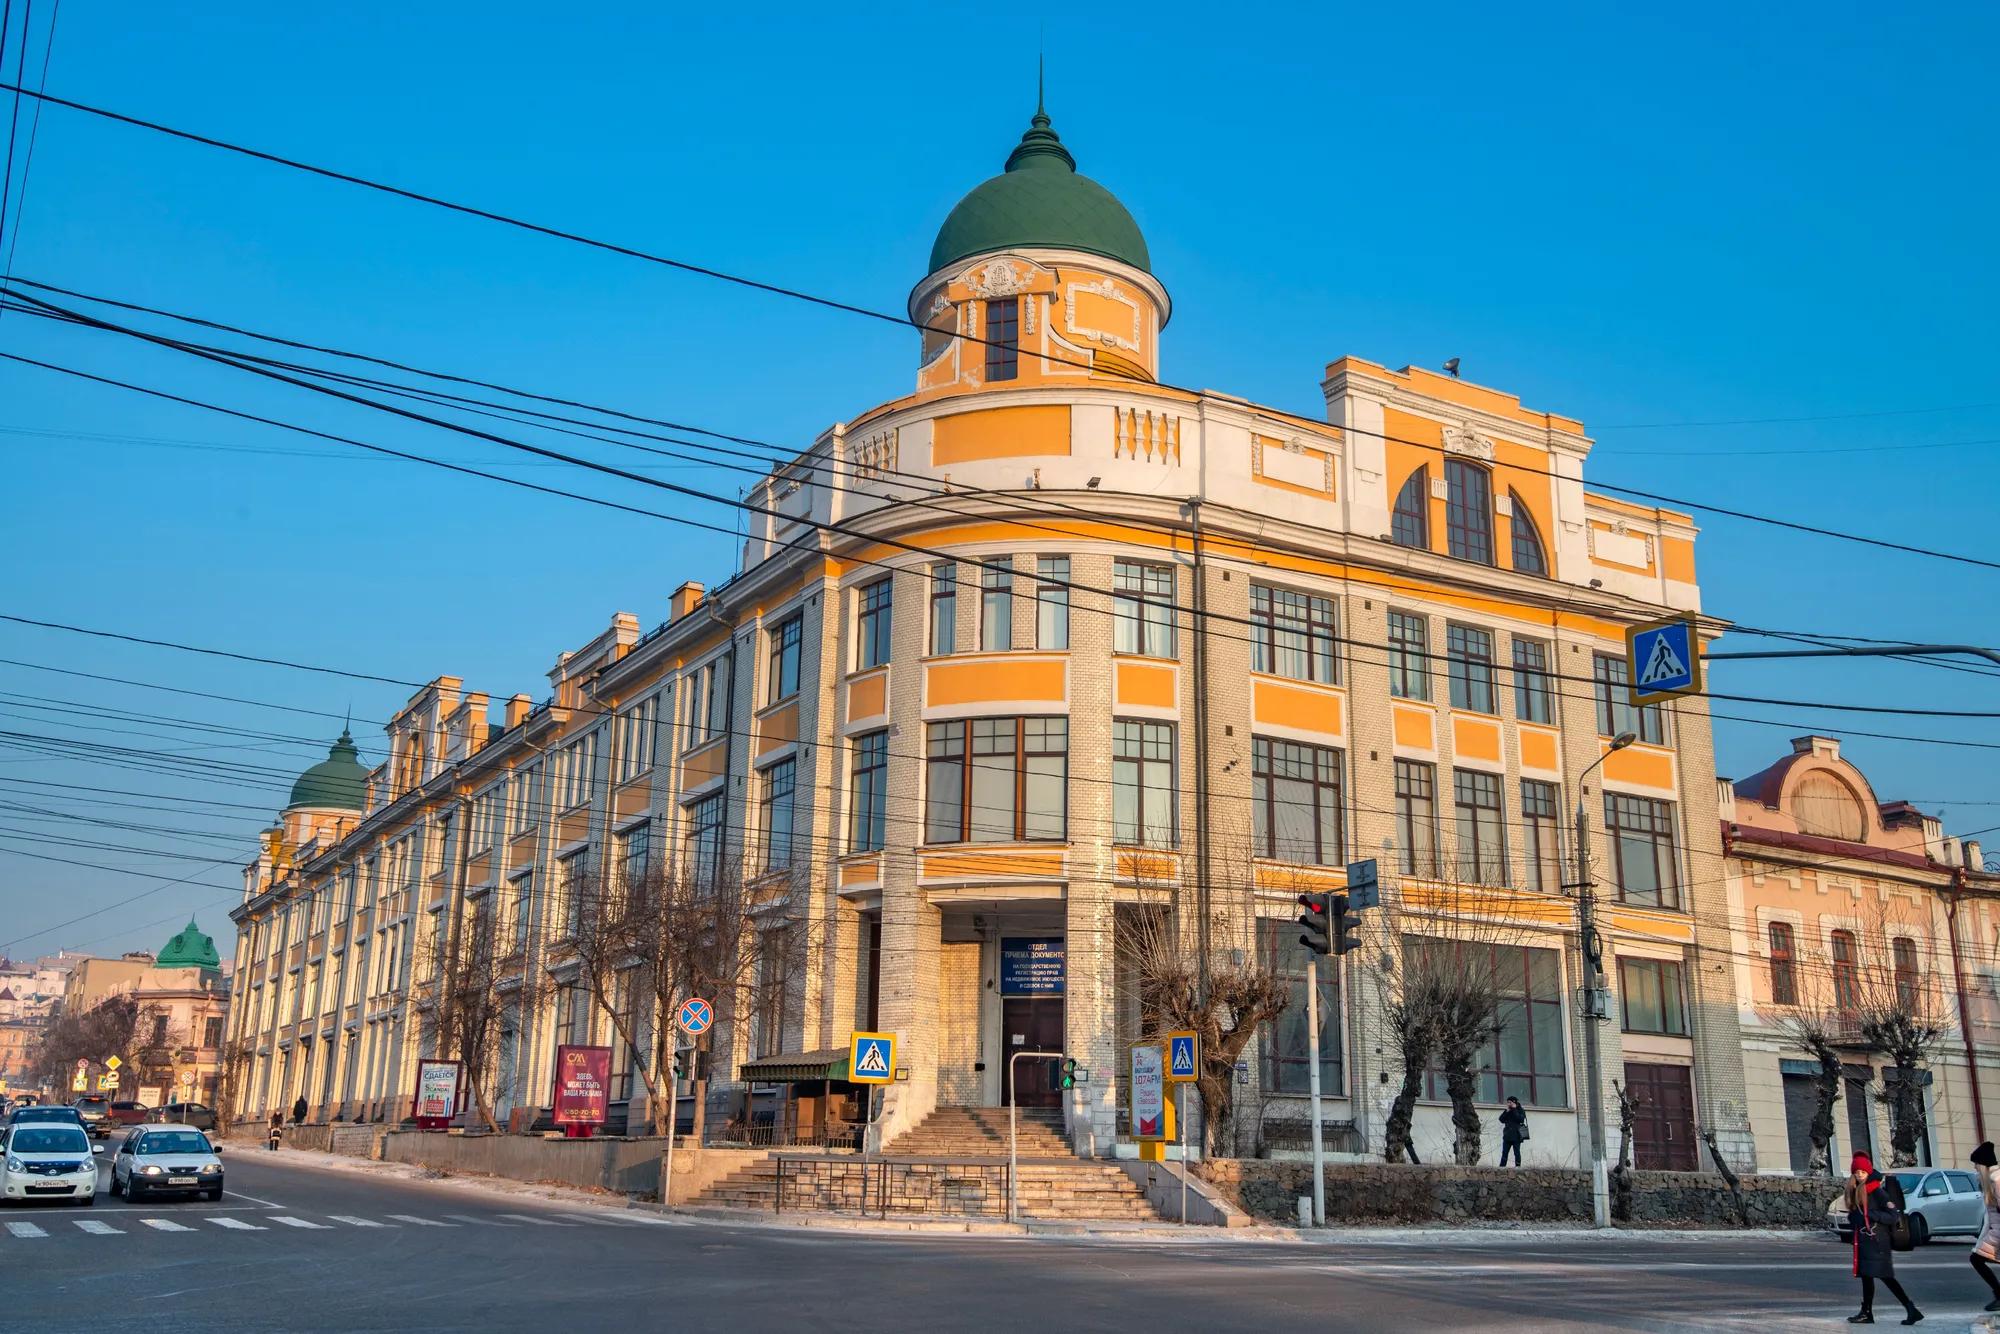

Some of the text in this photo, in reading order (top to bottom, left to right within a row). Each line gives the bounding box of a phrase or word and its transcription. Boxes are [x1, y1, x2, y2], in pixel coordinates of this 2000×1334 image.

[1027, 943, 1048, 951] ОТДЕЛ
[1031, 951, 1065, 959] ДОКУМЕНТО
[576, 1072, 593, 1080] ЗДЕСЬ
[567, 1081, 601, 1089] МОЖЕТ БЫТЬ
[563, 1089, 603, 1097] ВАША РЕКЛАМА
